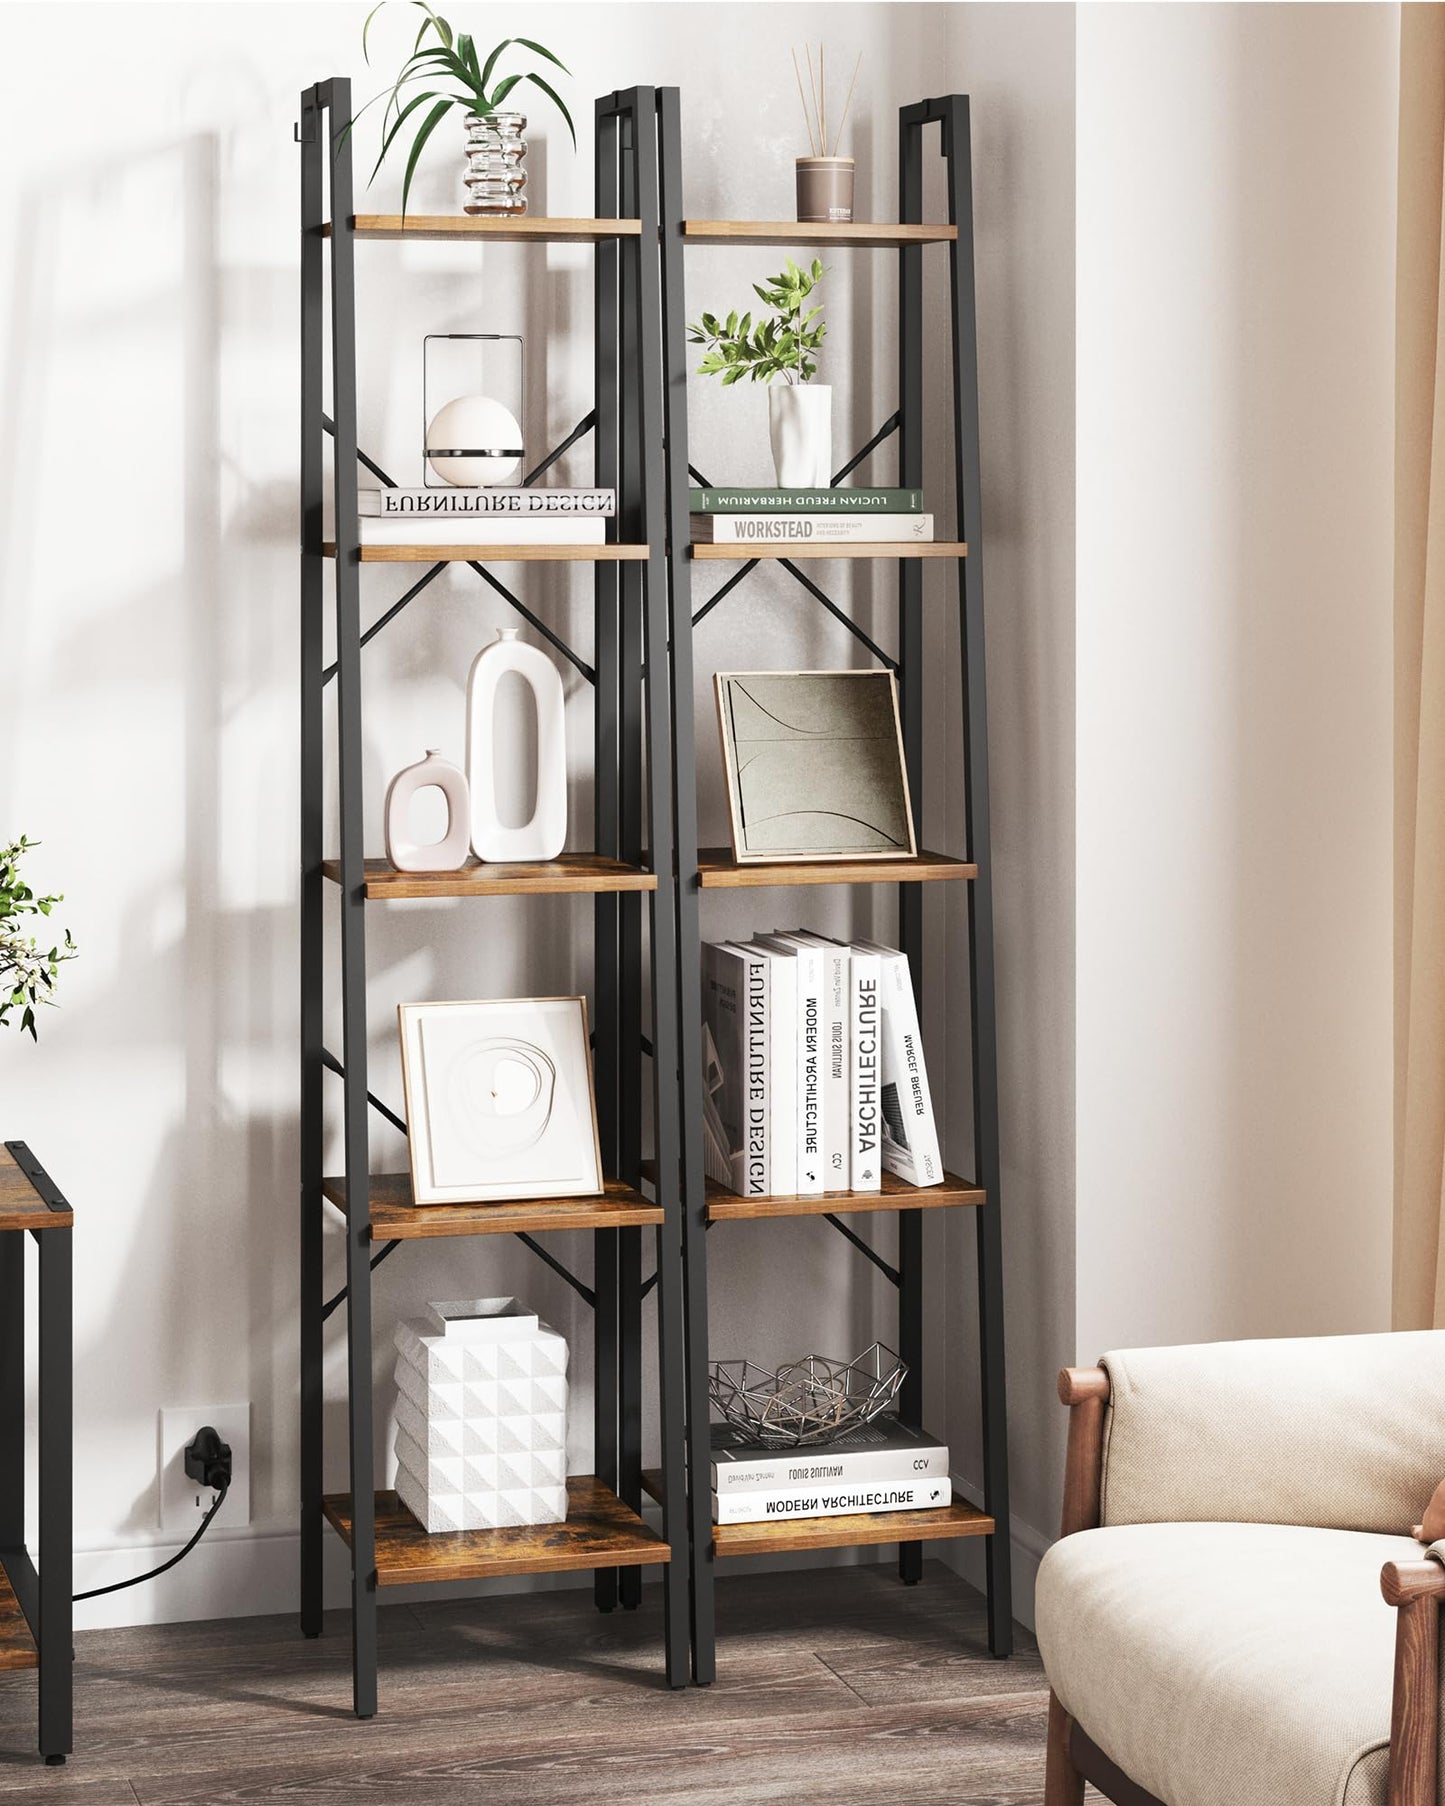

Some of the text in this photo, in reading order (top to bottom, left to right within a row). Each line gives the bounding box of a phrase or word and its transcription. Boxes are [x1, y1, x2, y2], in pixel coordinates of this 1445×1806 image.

[718, 496, 792, 505] HERBARIUM
[796, 496, 836, 505] FREUD
[840, 496, 887, 505] LUCIAN
[734, 520, 813, 538] WORKSTEAD
